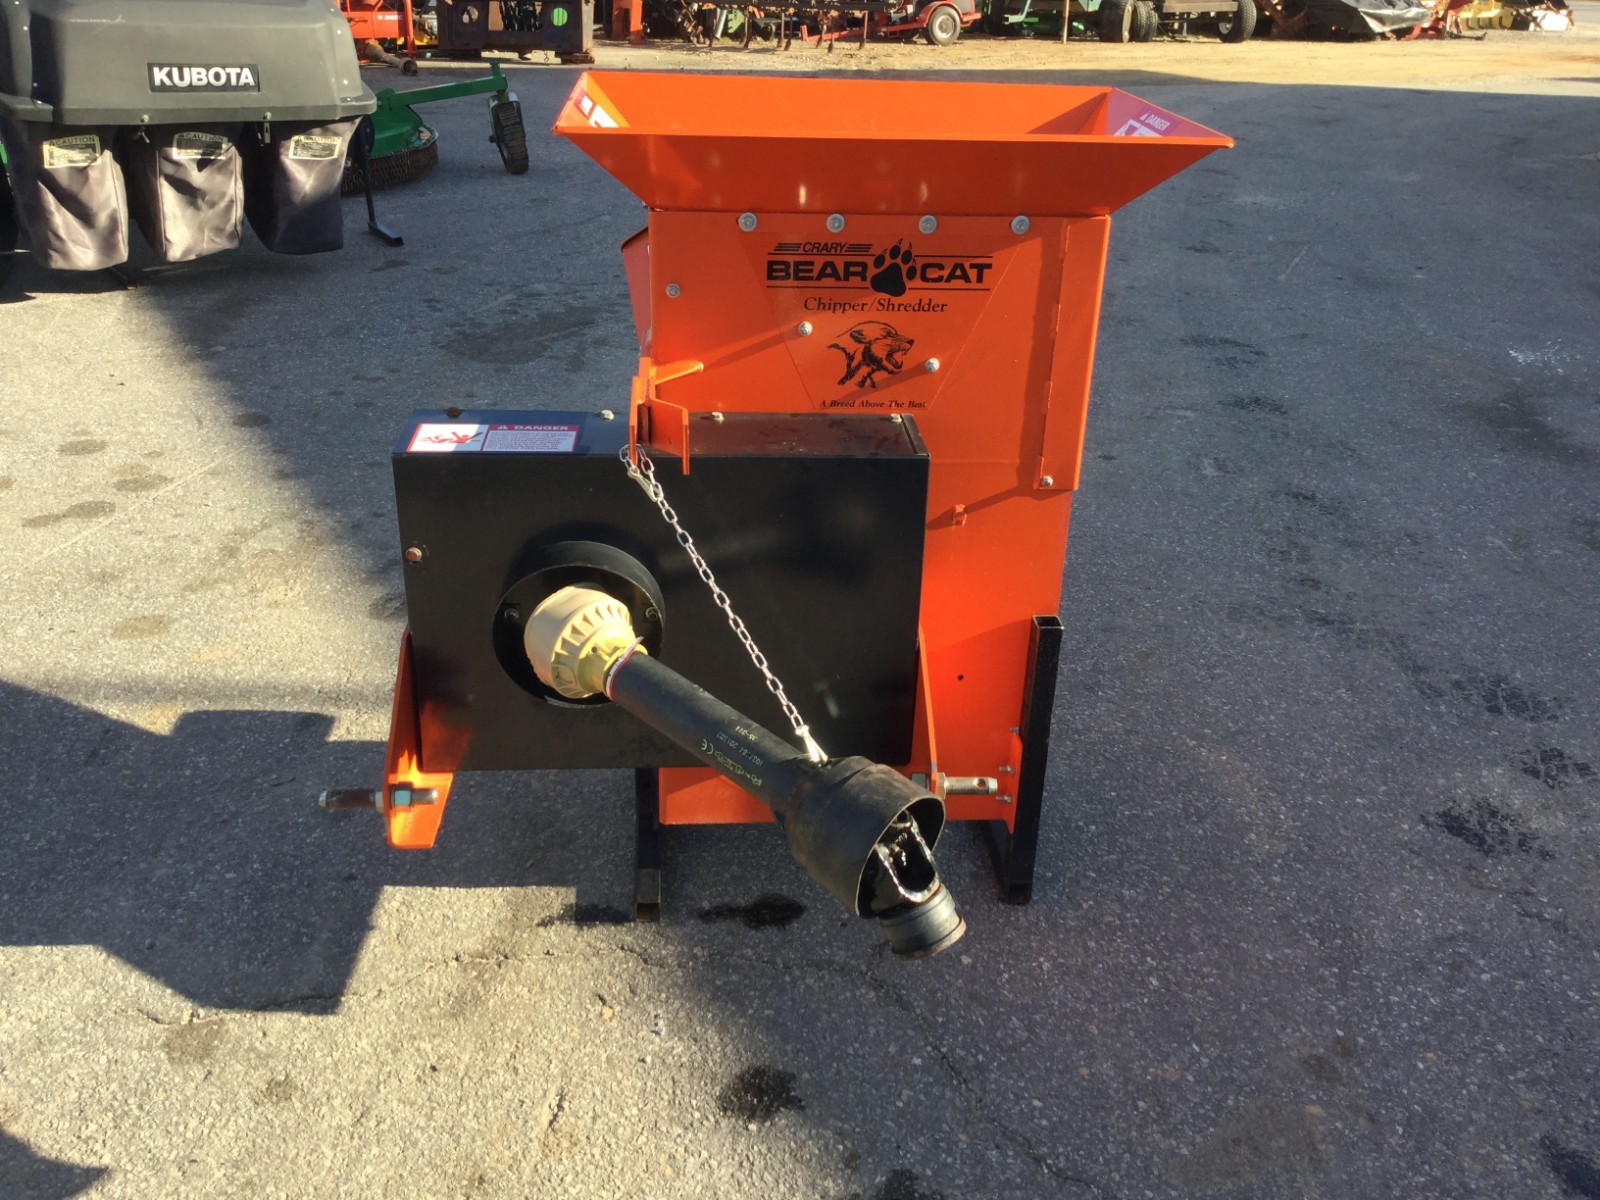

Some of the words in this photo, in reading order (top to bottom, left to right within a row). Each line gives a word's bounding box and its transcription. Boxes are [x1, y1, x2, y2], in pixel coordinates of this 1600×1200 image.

[153, 67, 255, 87] KUBOTA
[1145, 115, 1170, 131] DANGER
[56, 136, 95, 145] CAUTION
[186, 133, 224, 141] CAUTION
[802, 242, 847, 253] CRARY
[766, 260, 868, 281] BEAR
[920, 263, 992, 283] CAT
[804, 297, 948, 314] Chipper/Shredder
[830, 400, 855, 408] Breed
[858, 400, 884, 408] Above
